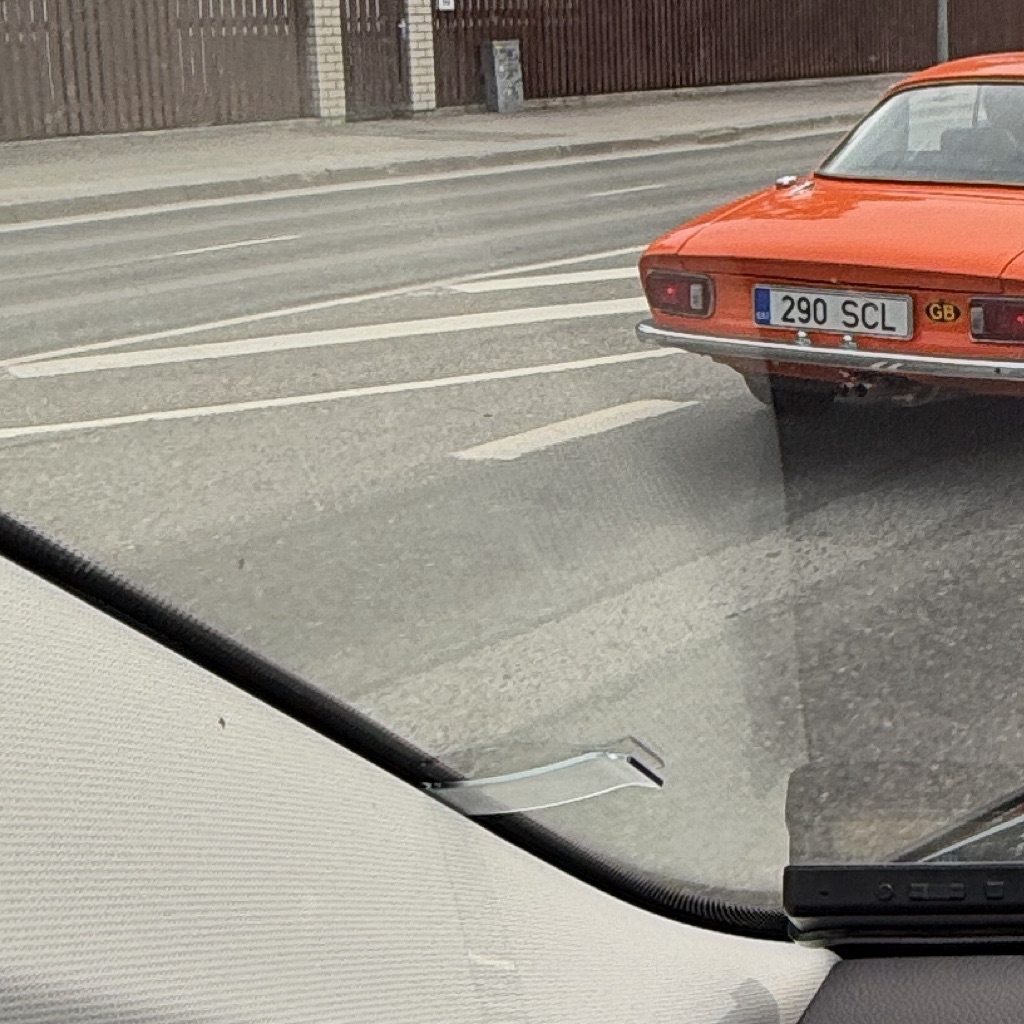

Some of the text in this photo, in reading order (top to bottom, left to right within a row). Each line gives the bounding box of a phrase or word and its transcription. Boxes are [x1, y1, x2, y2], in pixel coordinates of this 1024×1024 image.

[781, 295, 896, 332] 290 SCL
[929, 304, 956, 320] GB
